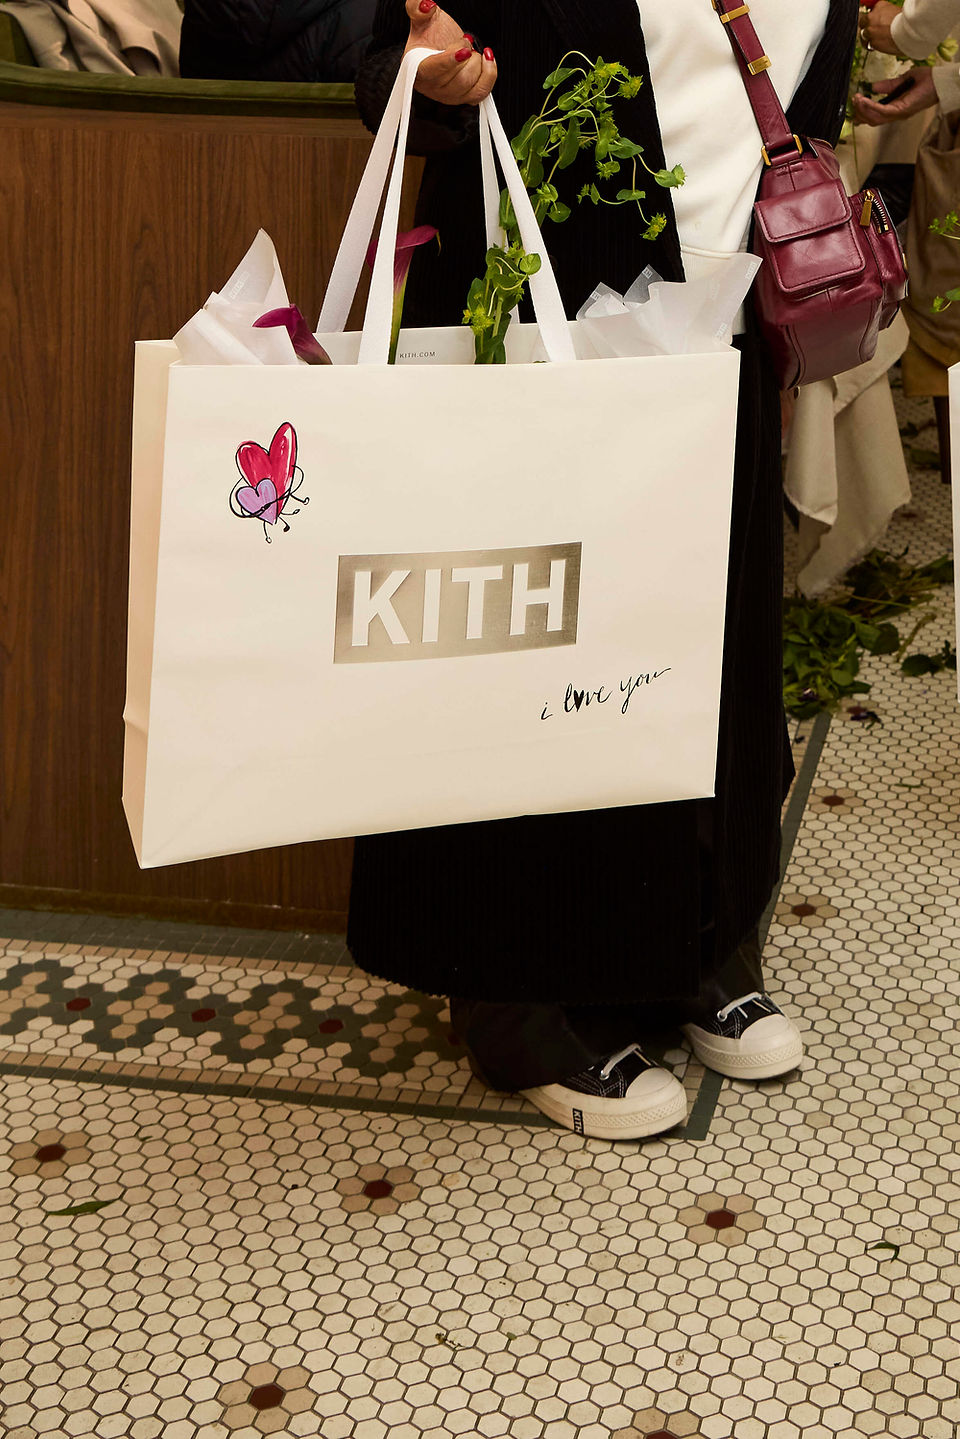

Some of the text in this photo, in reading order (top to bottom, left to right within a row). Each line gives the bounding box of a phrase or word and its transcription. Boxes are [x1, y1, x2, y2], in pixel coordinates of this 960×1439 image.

[351, 559, 568, 646] KITH
[539, 666, 672, 722] i love you
